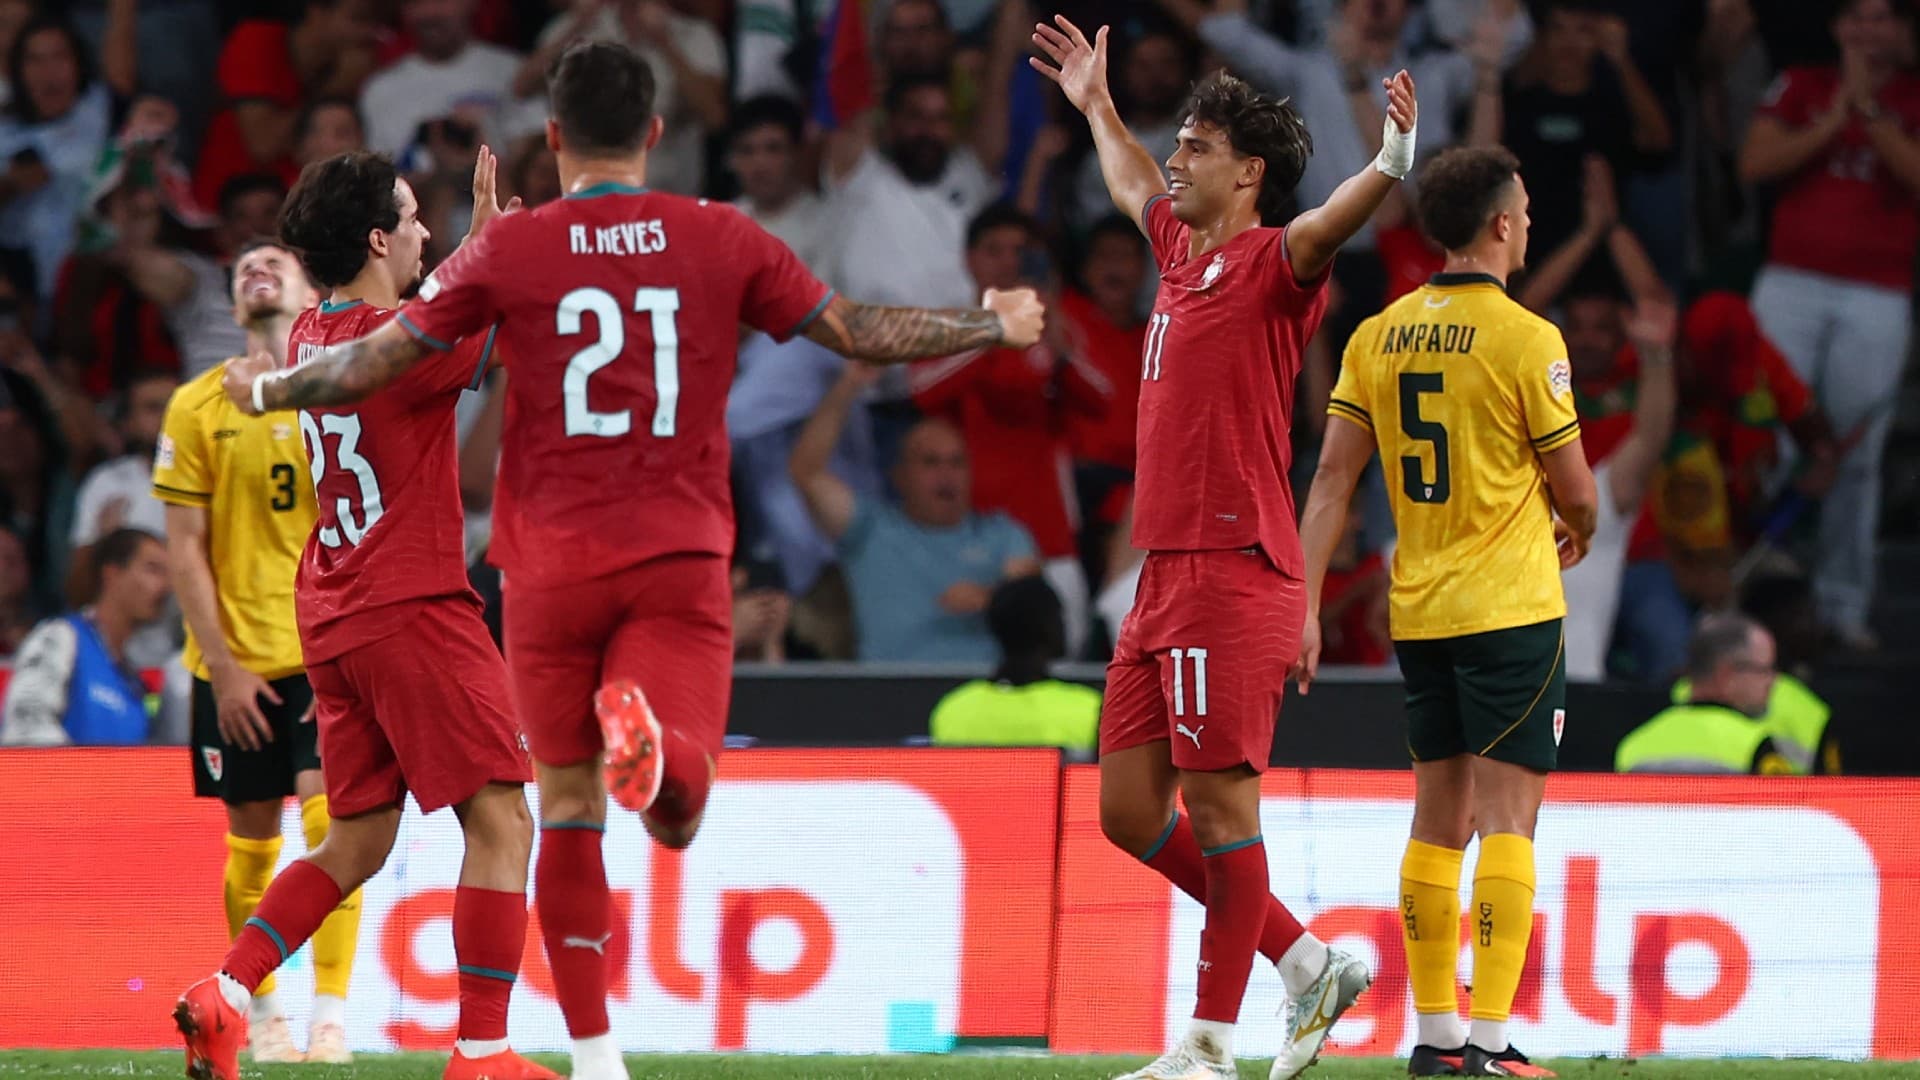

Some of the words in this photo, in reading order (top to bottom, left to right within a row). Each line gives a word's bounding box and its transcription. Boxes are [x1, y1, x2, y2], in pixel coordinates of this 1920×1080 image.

[569, 224, 593, 253] R.
[596, 219, 666, 255] NEVES
[556, 286, 680, 437] 21
[1143, 312, 1170, 381] 11
[1382, 323, 1476, 355] AMPADU
[1399, 372, 1450, 504] 5
[271, 463, 296, 511] 3
[299, 409, 384, 548] 23
[1170, 648, 1208, 716] 11
[1479, 902, 1494, 947] CYMRU
